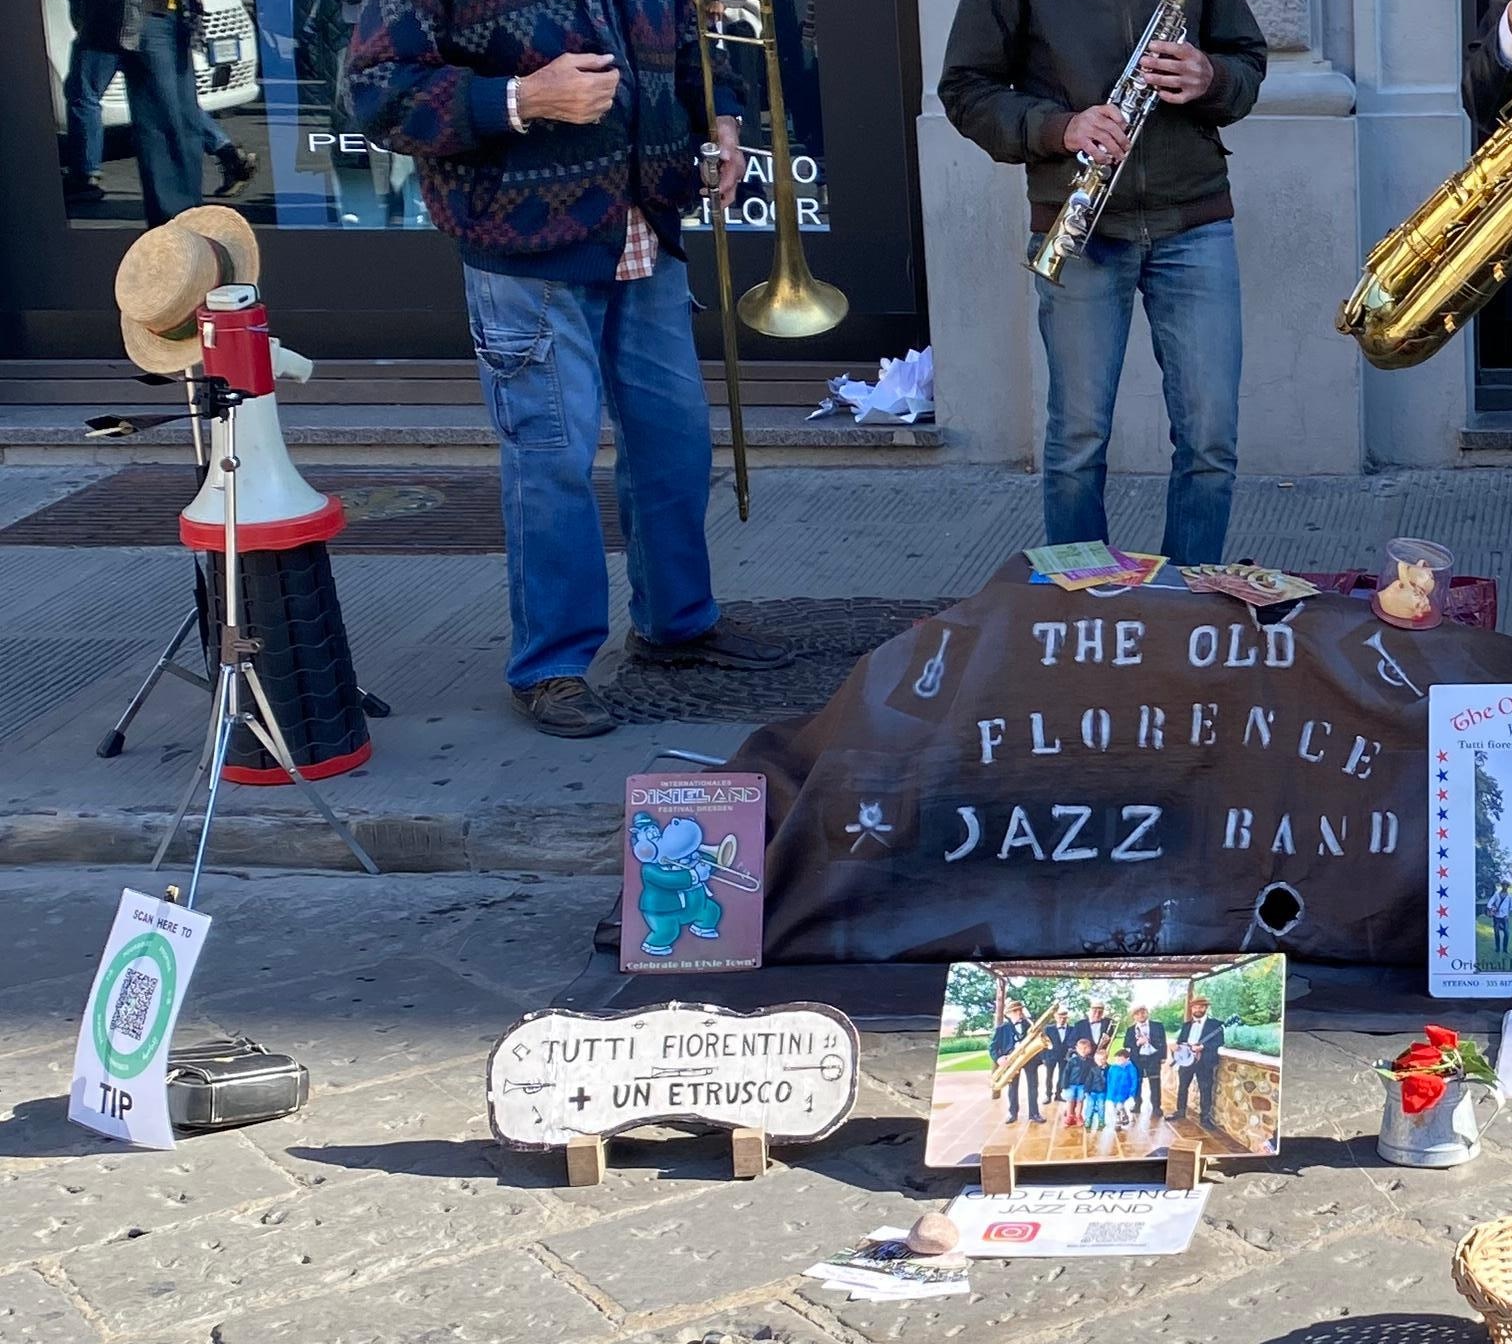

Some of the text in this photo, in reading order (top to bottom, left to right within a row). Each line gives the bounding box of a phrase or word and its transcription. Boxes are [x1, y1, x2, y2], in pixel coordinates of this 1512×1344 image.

[1032, 618, 1295, 667] THE OLD
[1450, 706, 1494, 732] The
[977, 703, 1381, 780] FLORENCE
[1458, 740, 1483, 749] Tutti
[631, 787, 761, 805] DIXIELAND
[944, 804, 1399, 862] JAZZ BAND
[133, 909, 192, 938] SCAN HERE TO
[1451, 959, 1505, 974] Original
[542, 1032, 813, 1064] TUTTI FIORENTINI
[100, 1082, 133, 1120] TIP
[613, 1084, 650, 1108] UN
[669, 1081, 792, 1105] ETRUSCO
[998, 1203, 1153, 1214] JAZZ BAND
